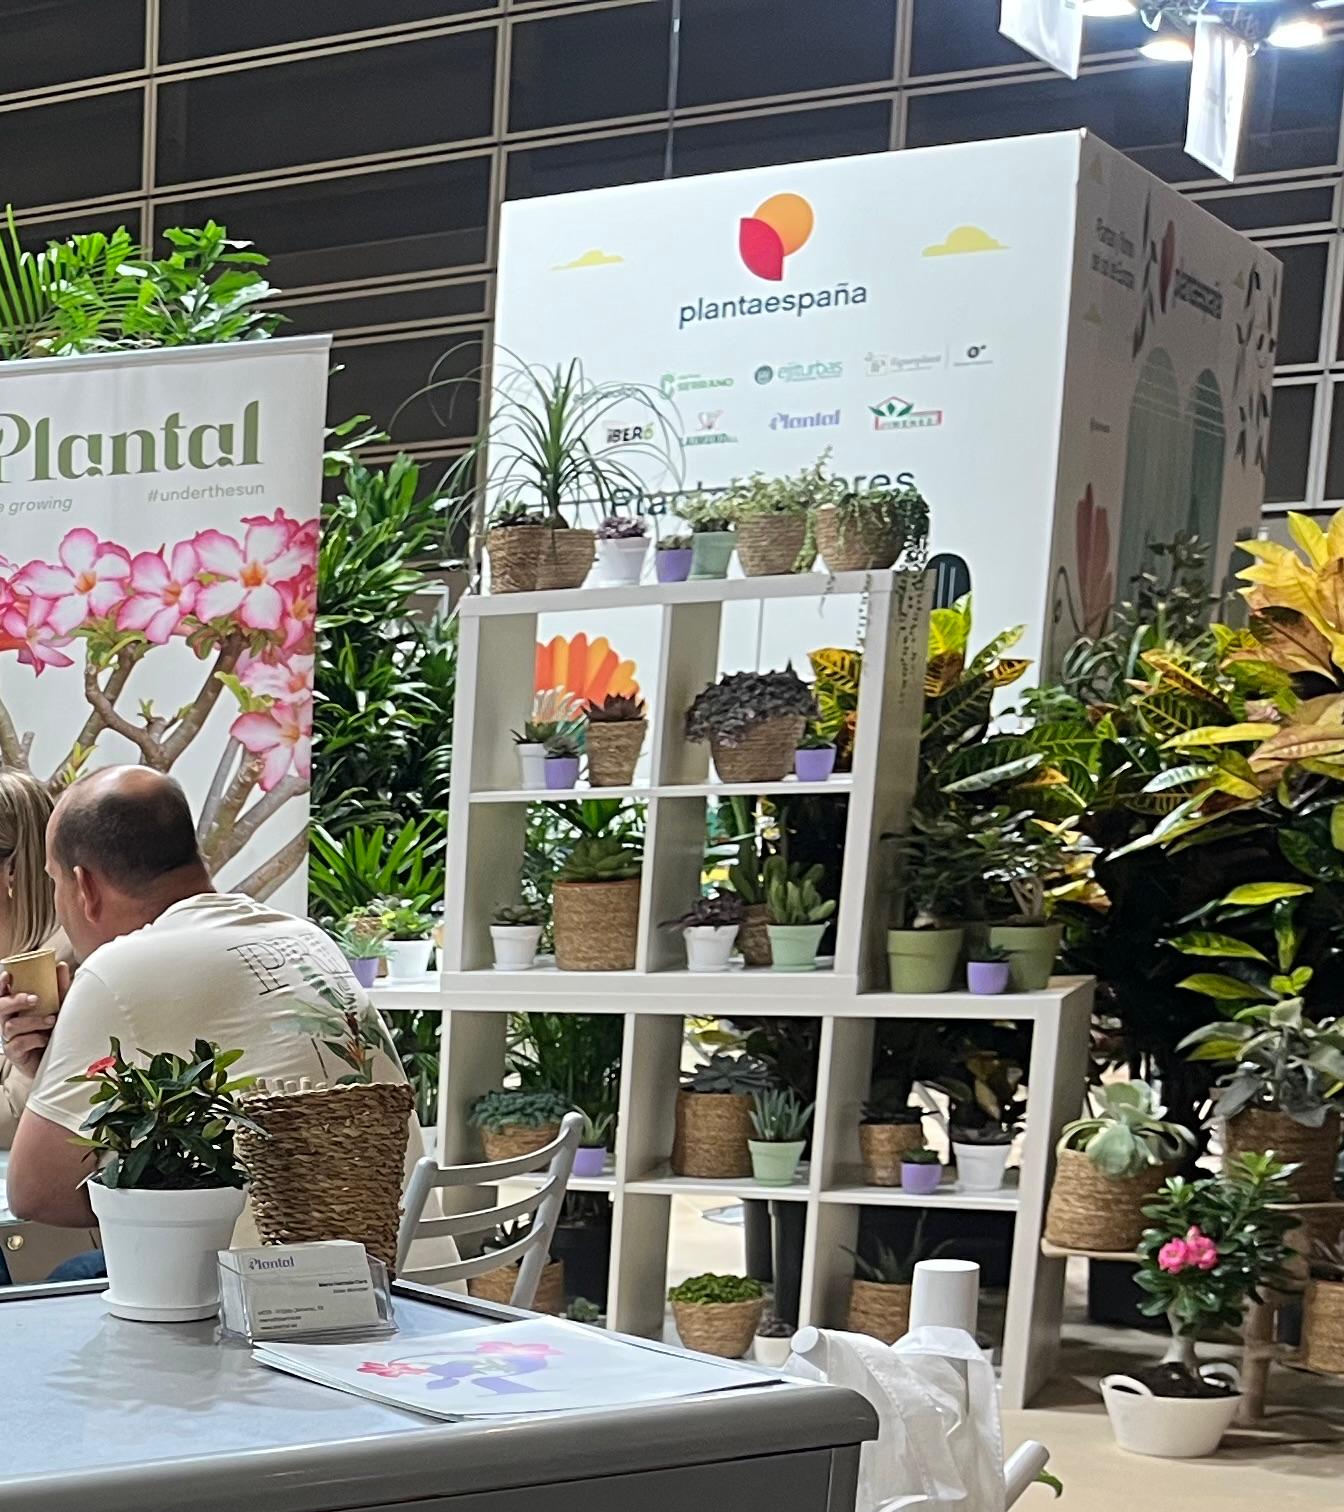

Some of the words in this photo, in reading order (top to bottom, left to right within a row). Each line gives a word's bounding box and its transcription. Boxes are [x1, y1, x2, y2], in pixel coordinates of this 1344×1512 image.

[679, 283, 868, 329] plantaespaña
[148, 483, 264, 502] #underthesun
[9, 496, 73, 515] growing
[249, 1256, 295, 1271] Plantal
